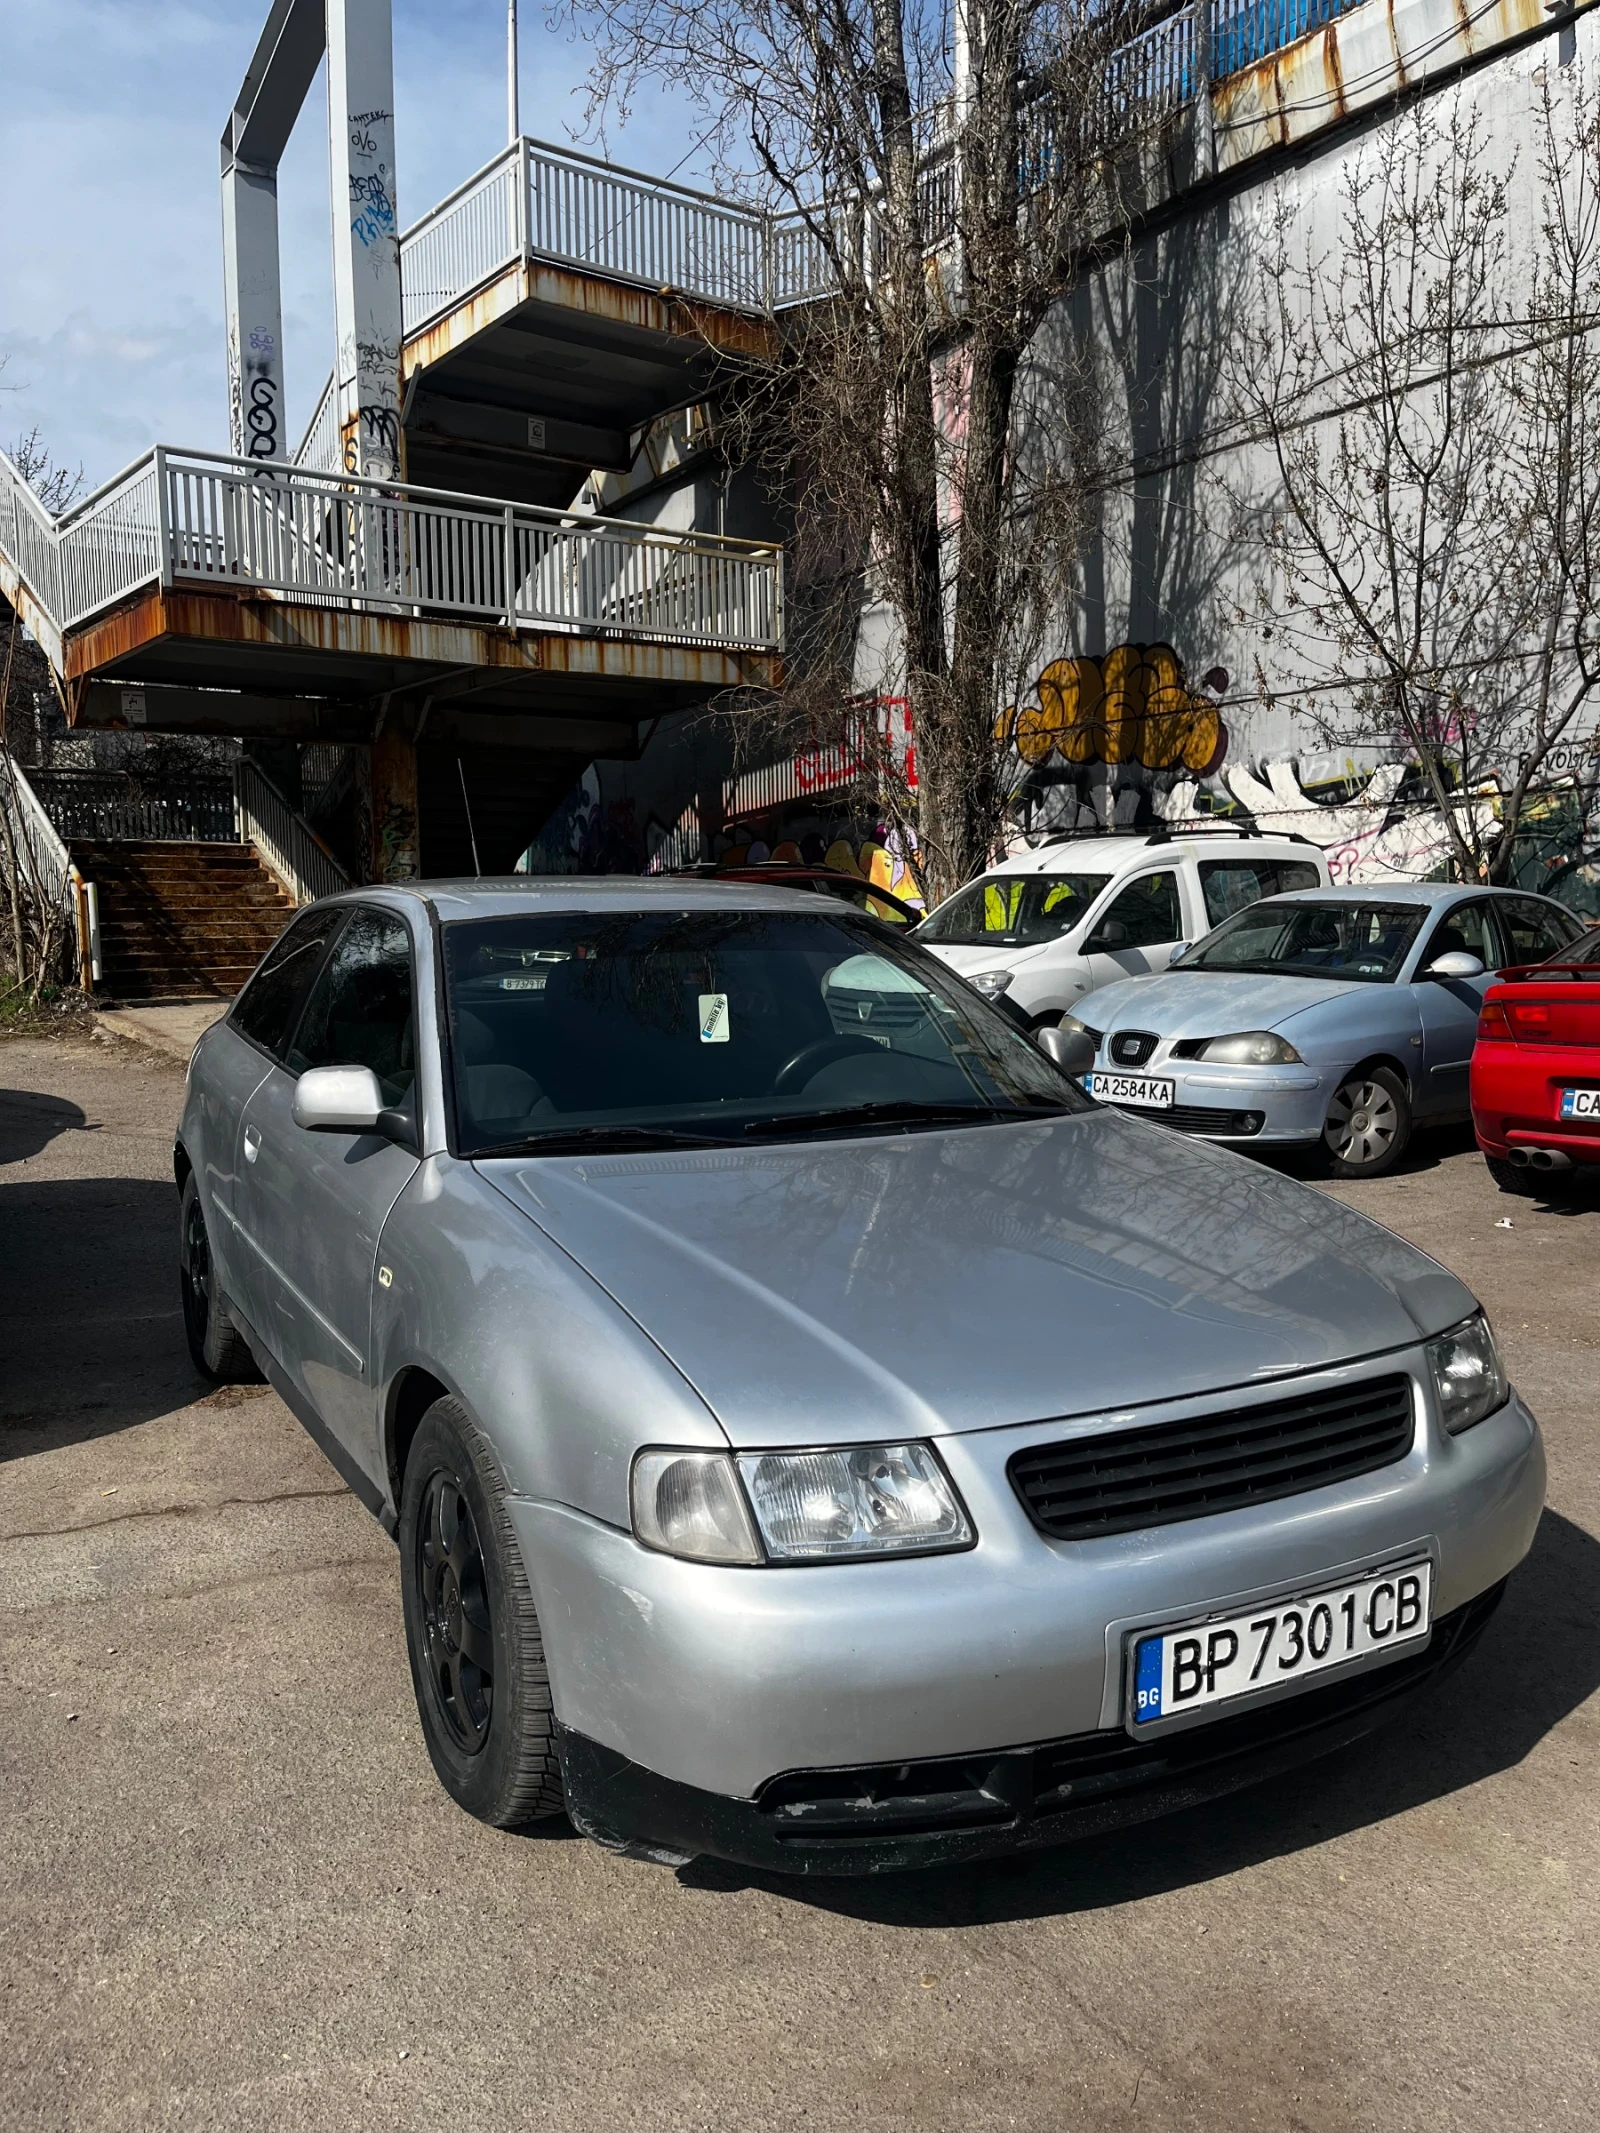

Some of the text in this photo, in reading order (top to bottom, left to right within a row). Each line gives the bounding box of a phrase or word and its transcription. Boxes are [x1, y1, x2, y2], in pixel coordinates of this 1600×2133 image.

[1112, 1078, 1146, 1099] 2584
[1149, 1082, 1169, 1102] KA
[1172, 1575, 1422, 1702] BP 7301 CB
[1137, 1687, 1160, 1709] BG
